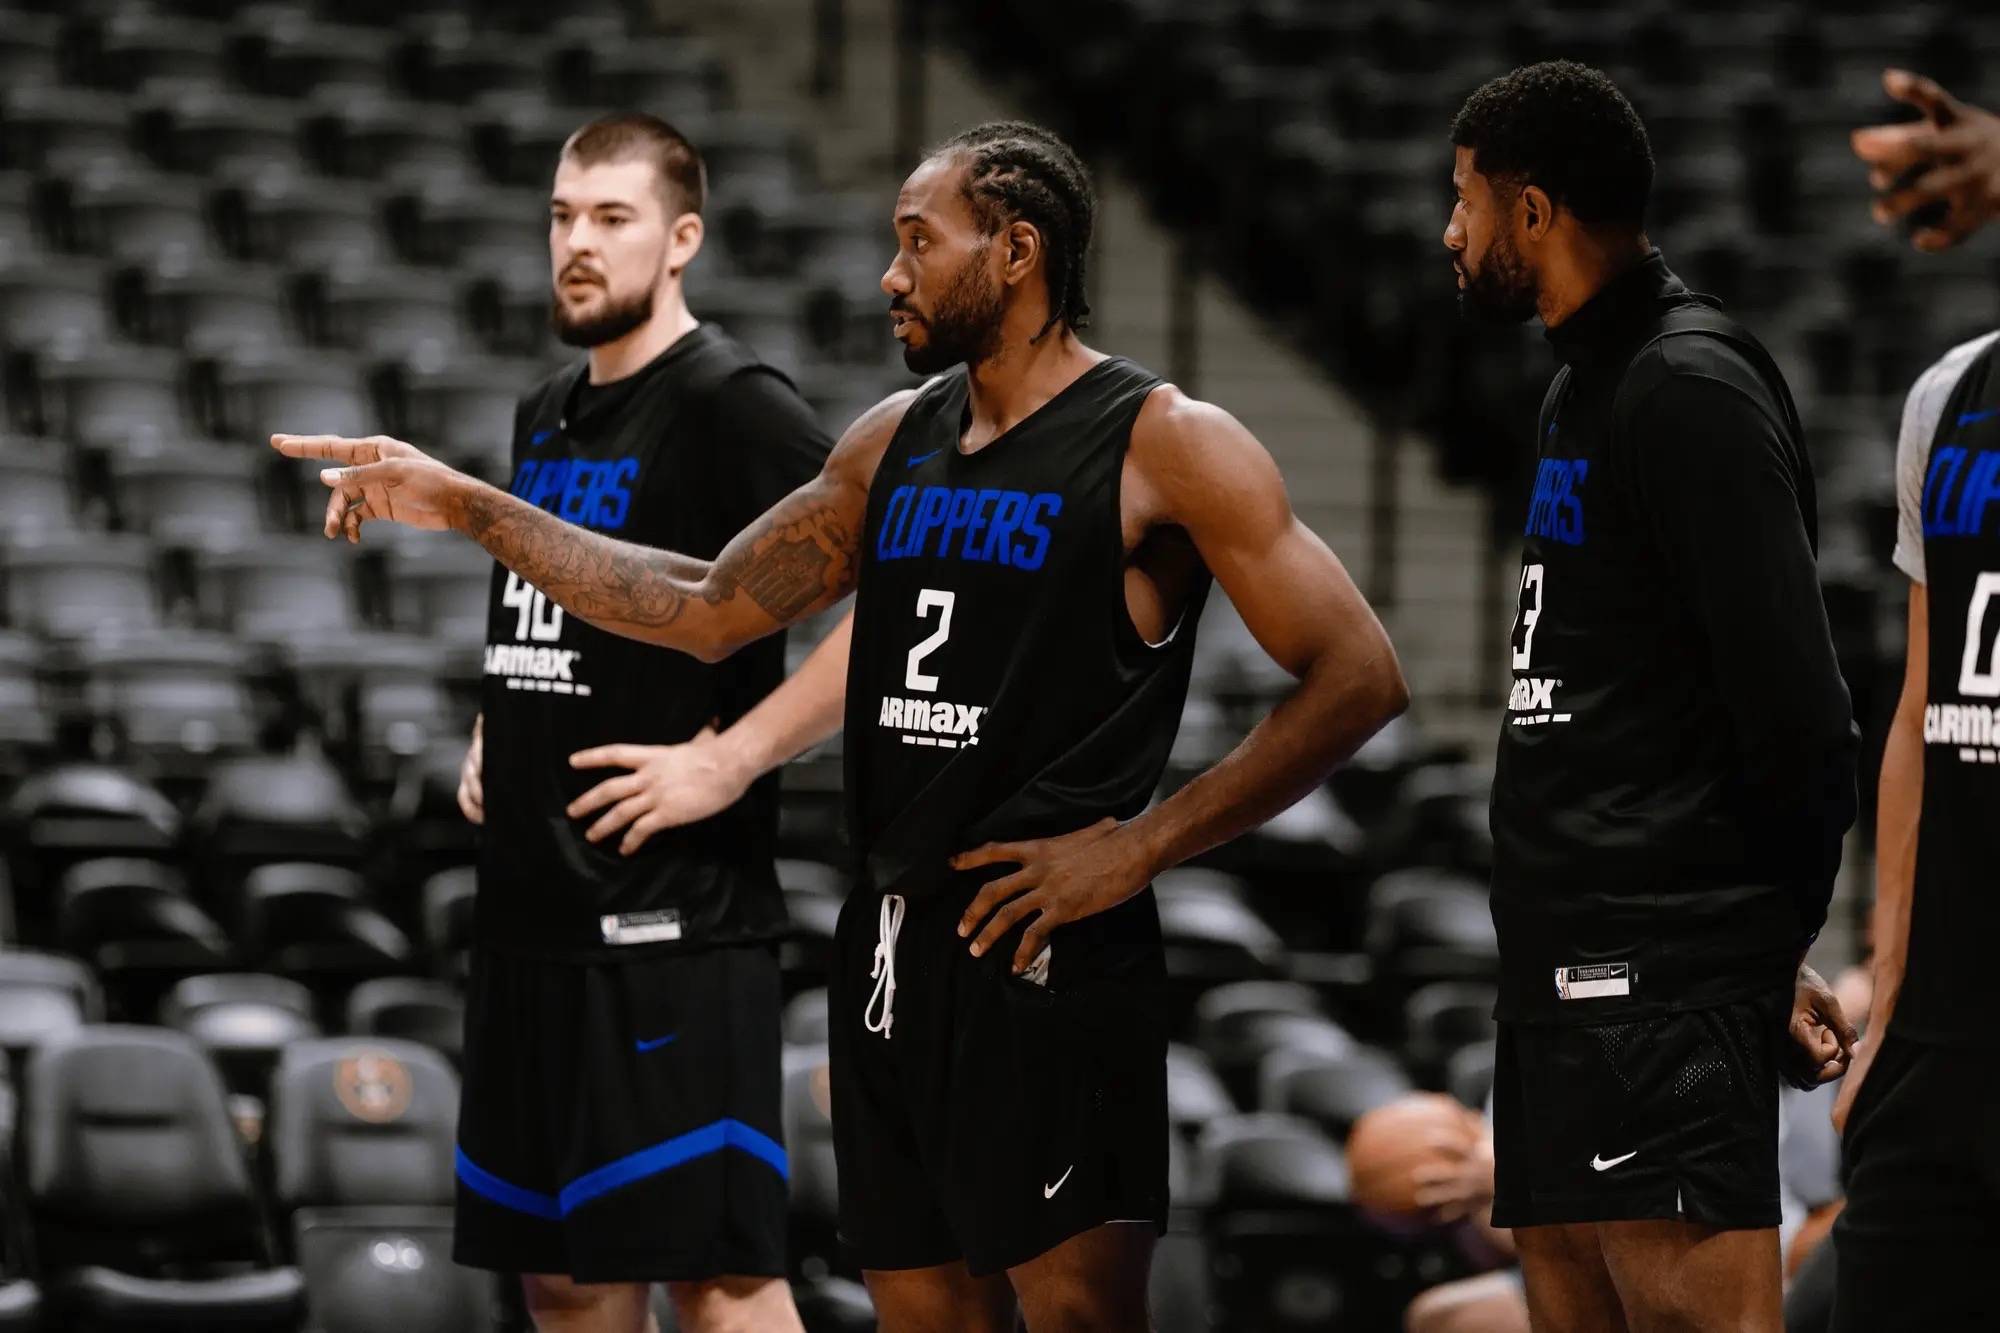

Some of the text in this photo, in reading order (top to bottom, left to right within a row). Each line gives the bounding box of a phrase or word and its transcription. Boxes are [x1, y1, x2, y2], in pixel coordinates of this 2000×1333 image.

[876, 484, 1063, 572] CLIPPERS
[904, 587, 956, 693] 2
[1510, 563, 1544, 671] 3
[879, 696, 984, 736] ARmax
